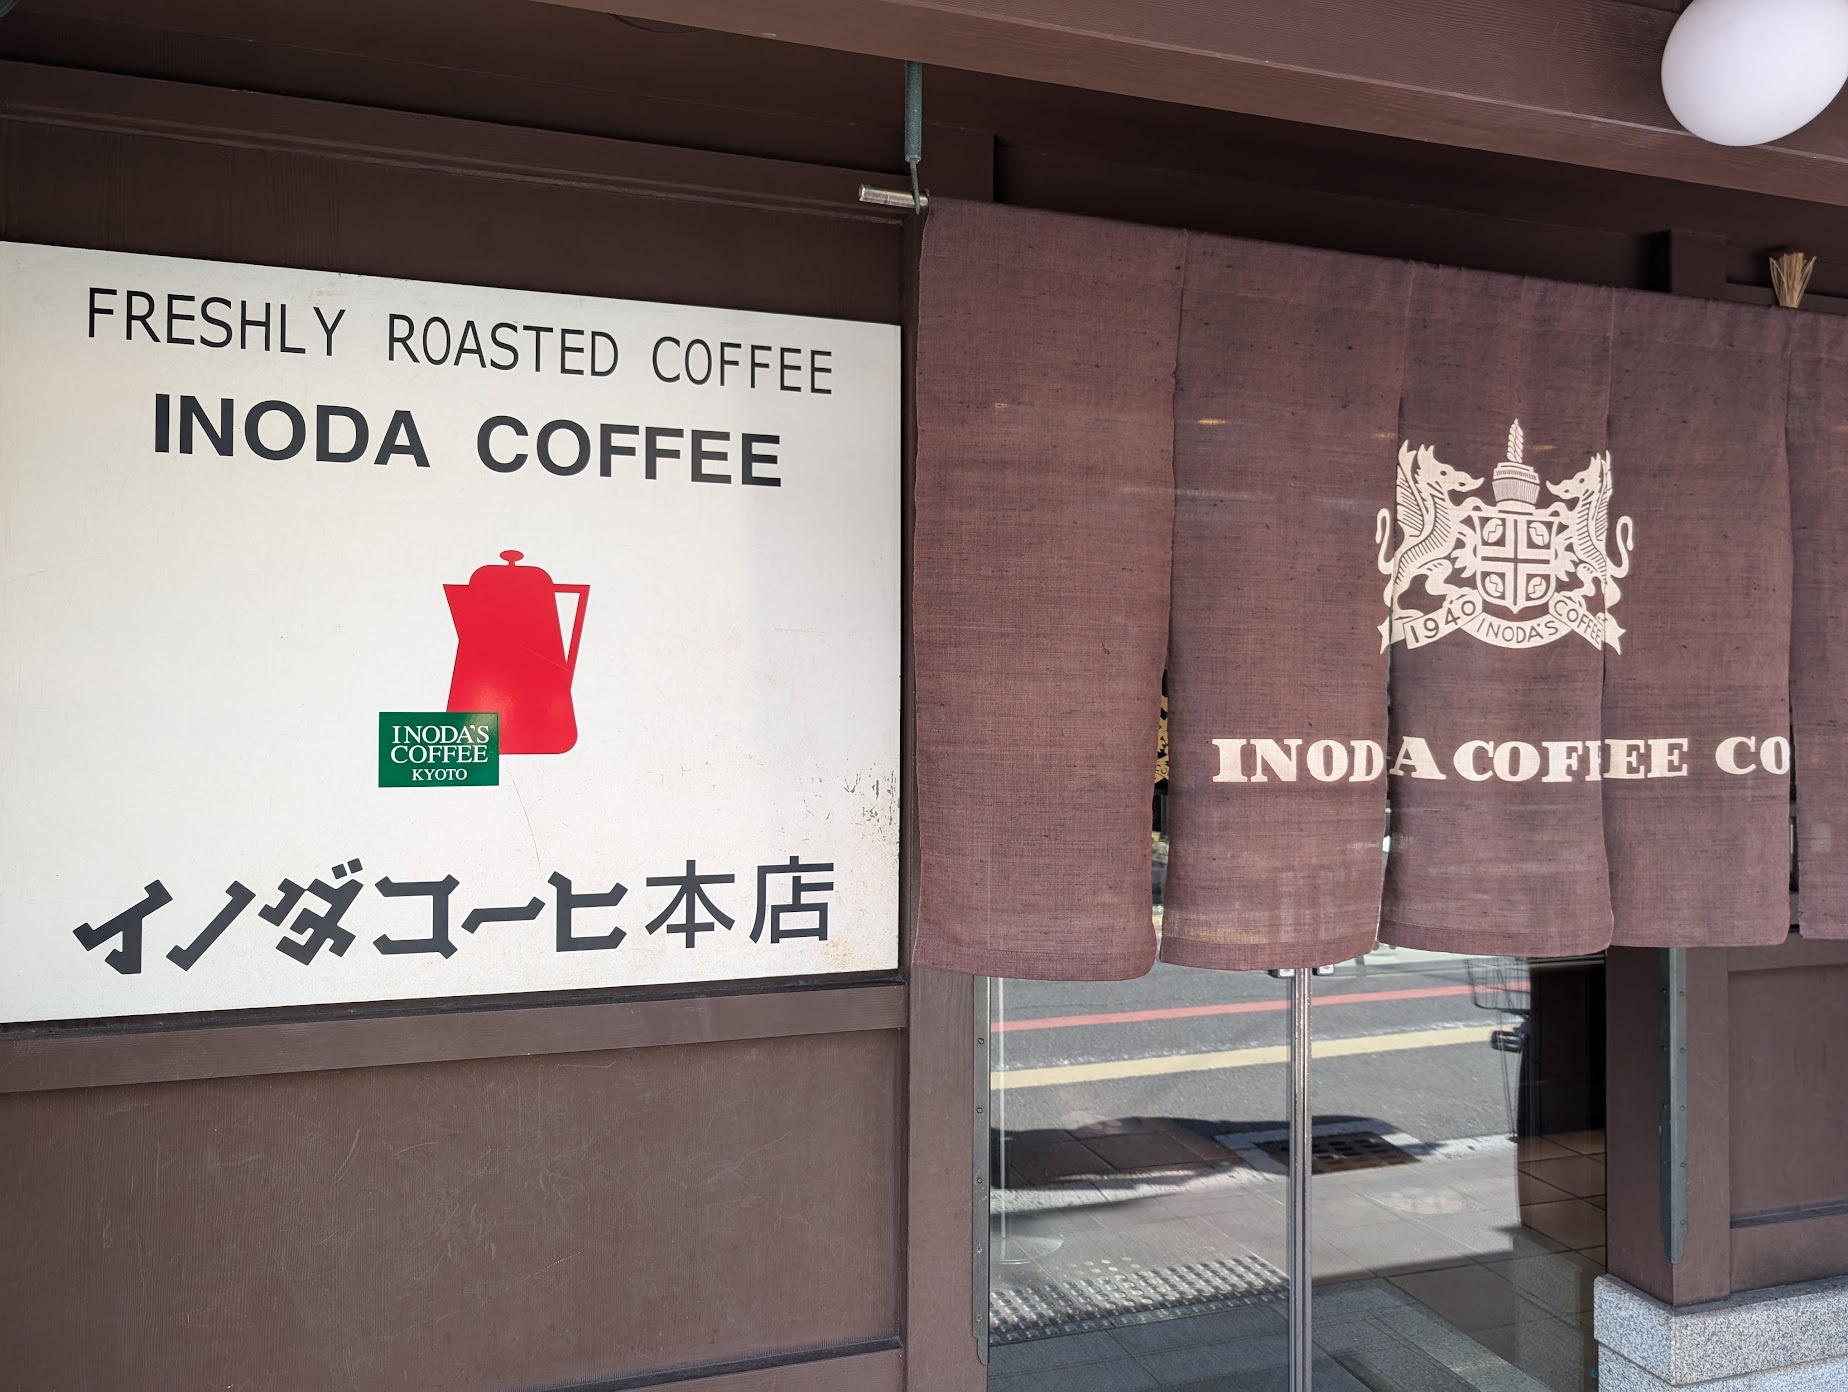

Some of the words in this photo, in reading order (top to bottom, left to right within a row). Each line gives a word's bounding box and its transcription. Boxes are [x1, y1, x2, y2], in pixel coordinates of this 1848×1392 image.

[88, 286, 346, 357] FRESHLY
[388, 313, 619, 377] ROASTED
[652, 336, 832, 395] COFFEE
[154, 393, 431, 468] INODA
[477, 415, 782, 488] COFFEE
[1410, 600, 1477, 644] 1940
[1476, 618, 1559, 644] INODA'S
[1553, 600, 1602, 645] COFFEE
[390, 745, 489, 764] COFFEE
[391, 724, 490, 744] INODA'S
[411, 768, 468, 781] KYOTO
[1211, 736, 1447, 783] INODA
[1714, 735, 1791, 775] CO
[72, 855, 836, 975] イノダコーヒ本店
